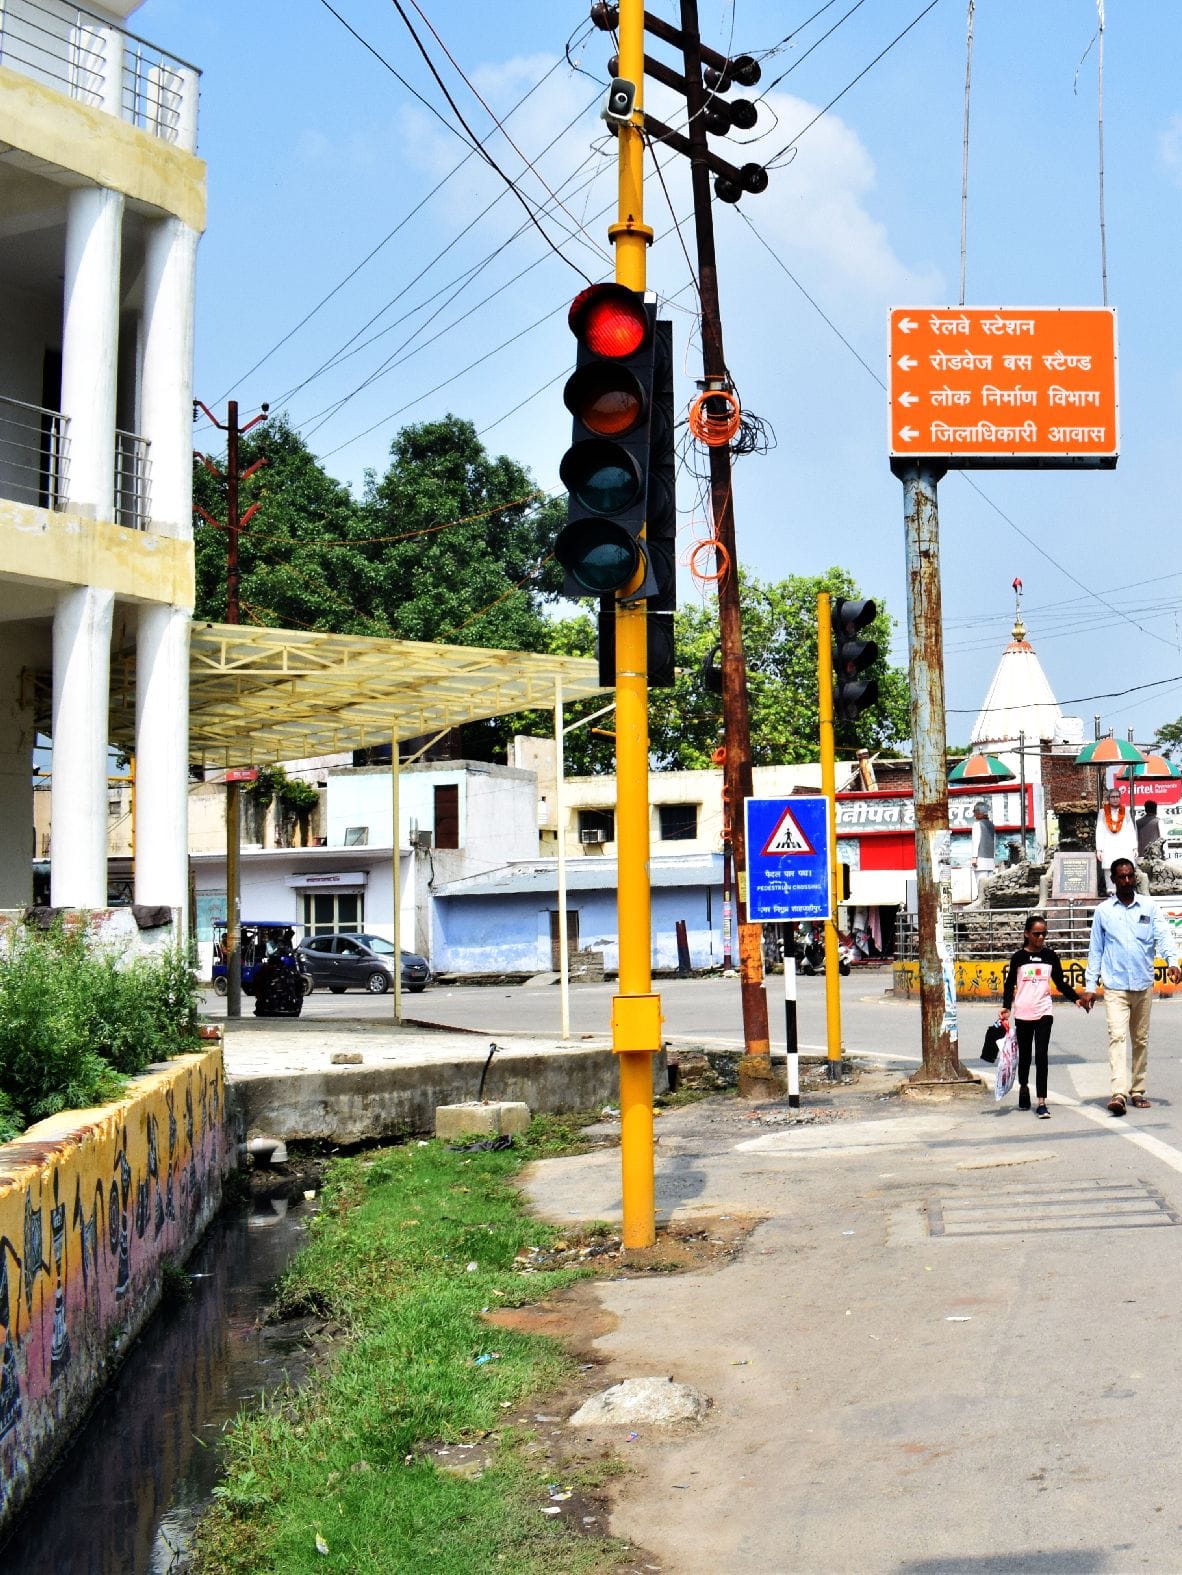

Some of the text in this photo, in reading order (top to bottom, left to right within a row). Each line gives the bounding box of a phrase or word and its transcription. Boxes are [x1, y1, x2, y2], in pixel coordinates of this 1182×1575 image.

[929, 314, 1035, 335] रेलवे स्टेशन
[929, 350, 992, 371] रोडवेज
[1003, 354, 1032, 371] बस
[929, 384, 1100, 407] लोक निर्माण विभाग
[930, 420, 1105, 443] जिलाधिकारी आवास
